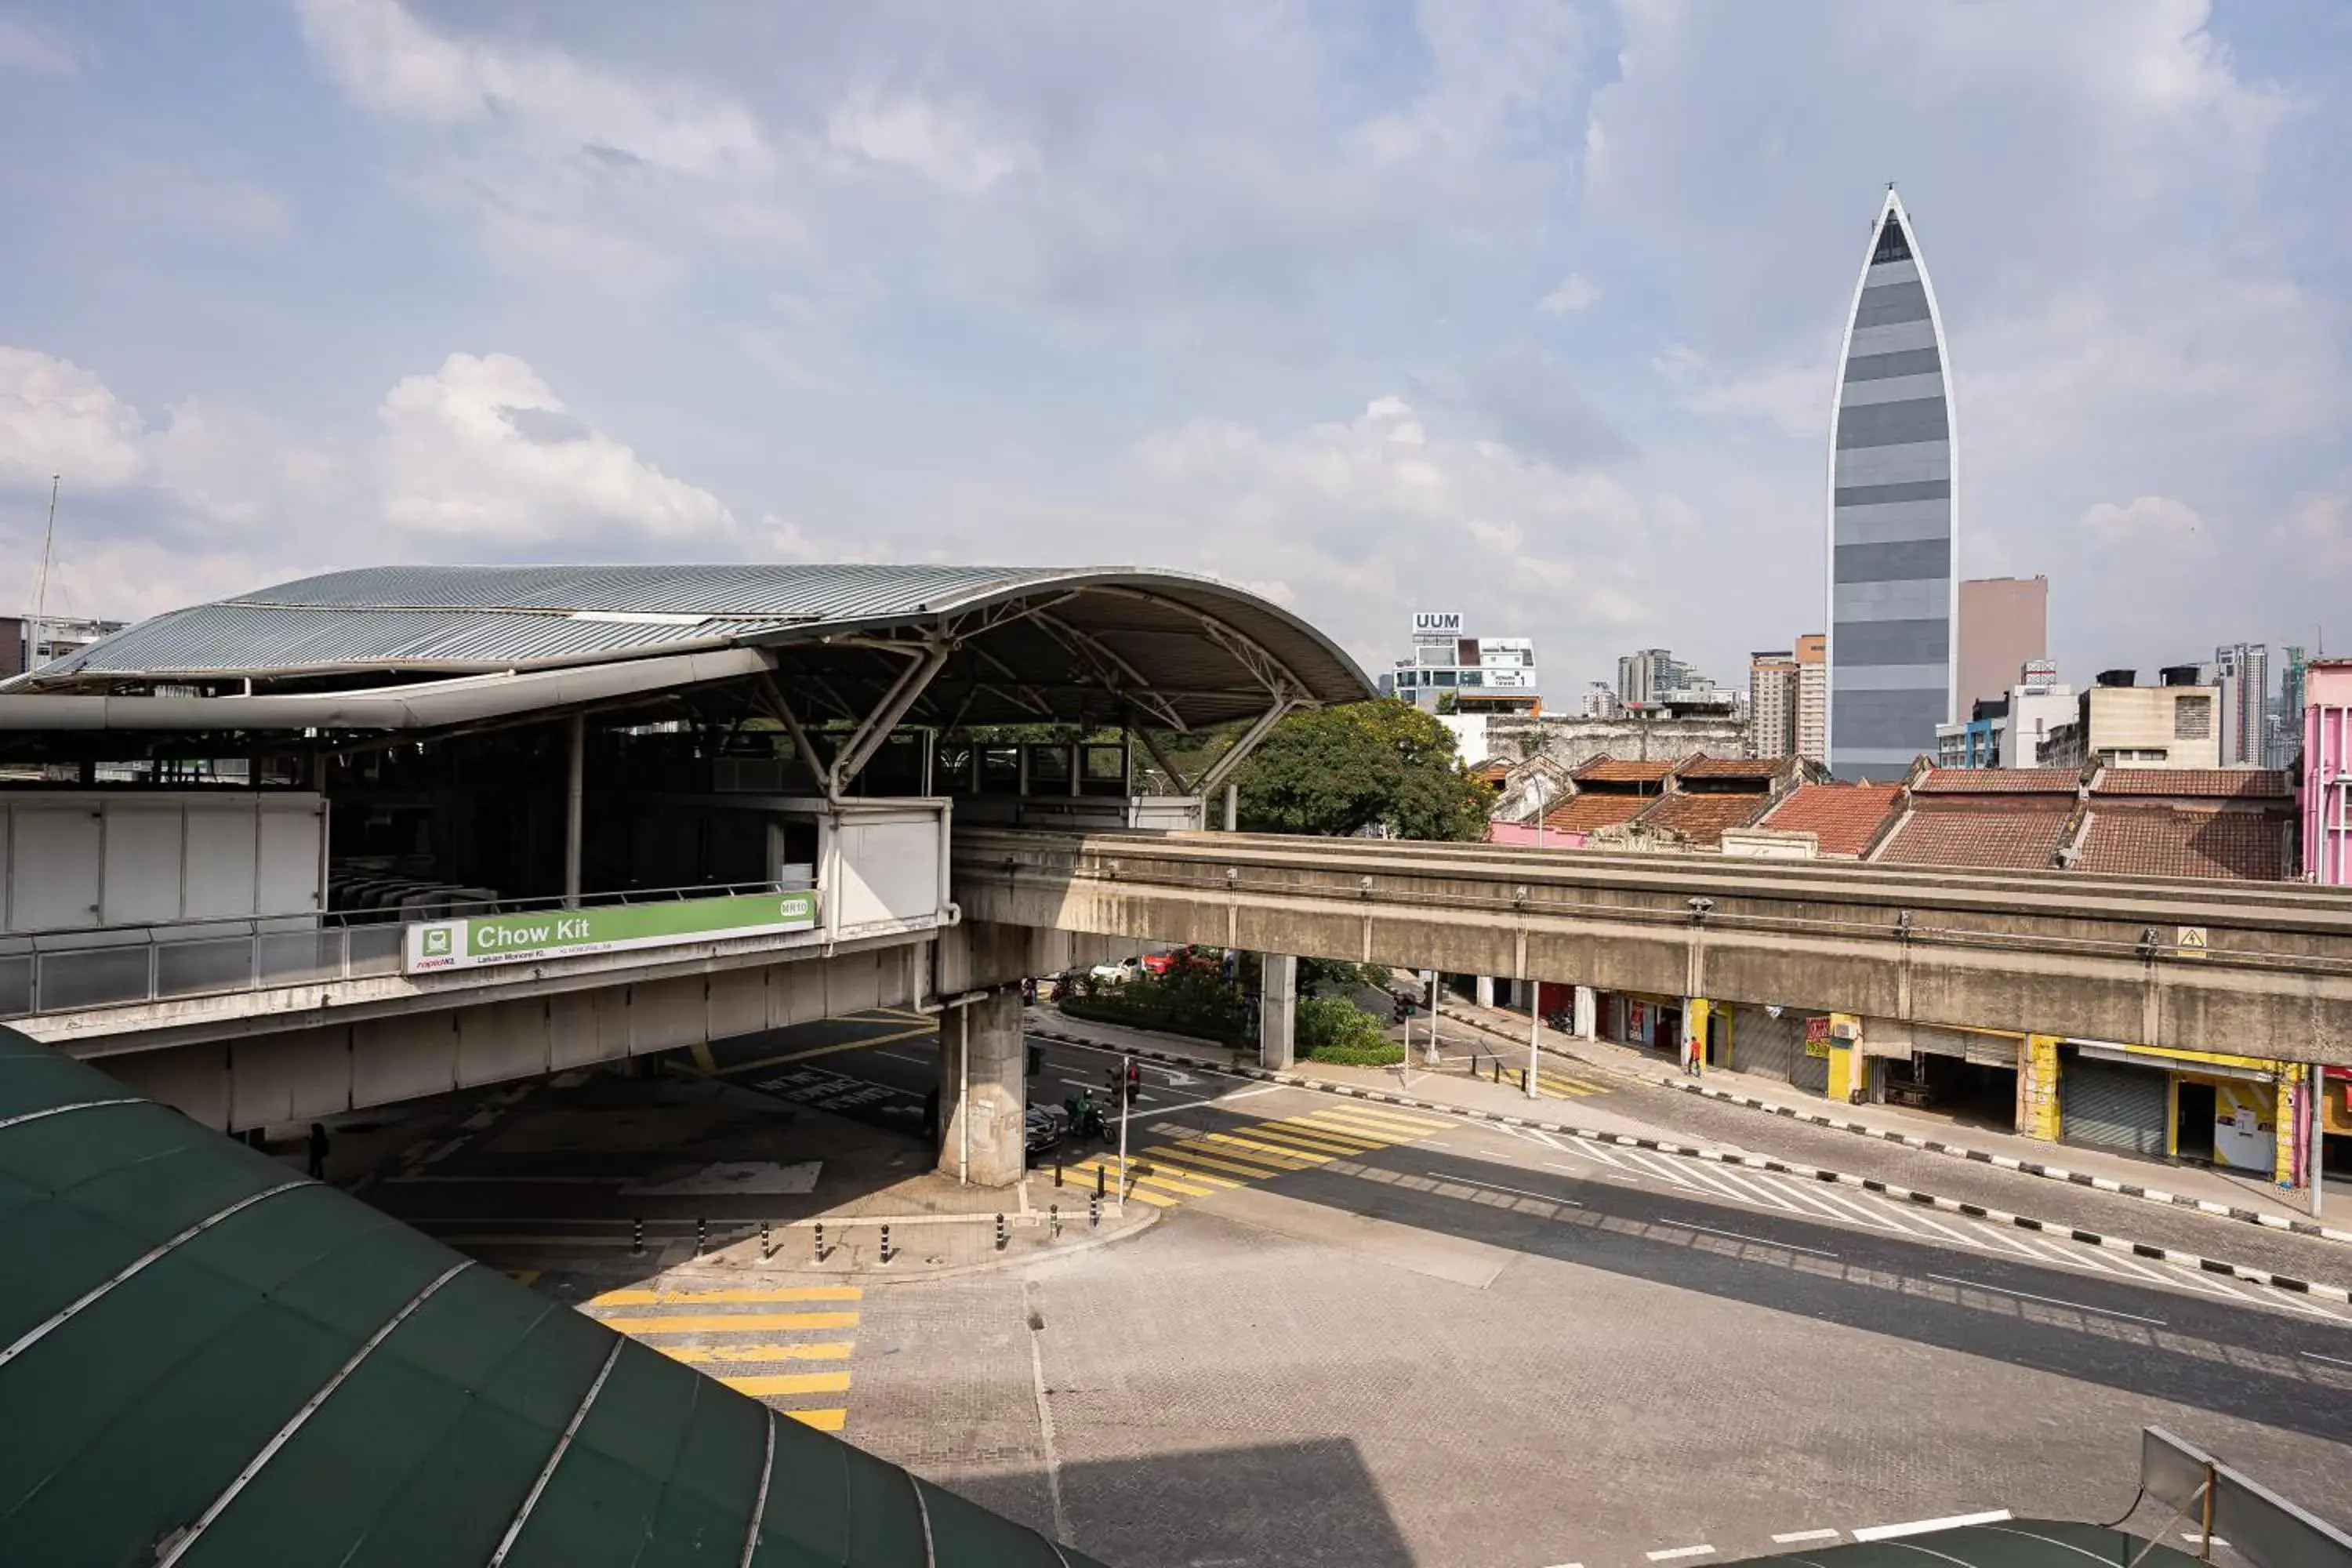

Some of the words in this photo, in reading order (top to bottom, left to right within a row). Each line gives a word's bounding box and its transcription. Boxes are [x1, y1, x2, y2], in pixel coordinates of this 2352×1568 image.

[1417, 614, 1459, 628] UUM
[477, 926, 550, 949] Chow
[557, 917, 590, 940] Kit
